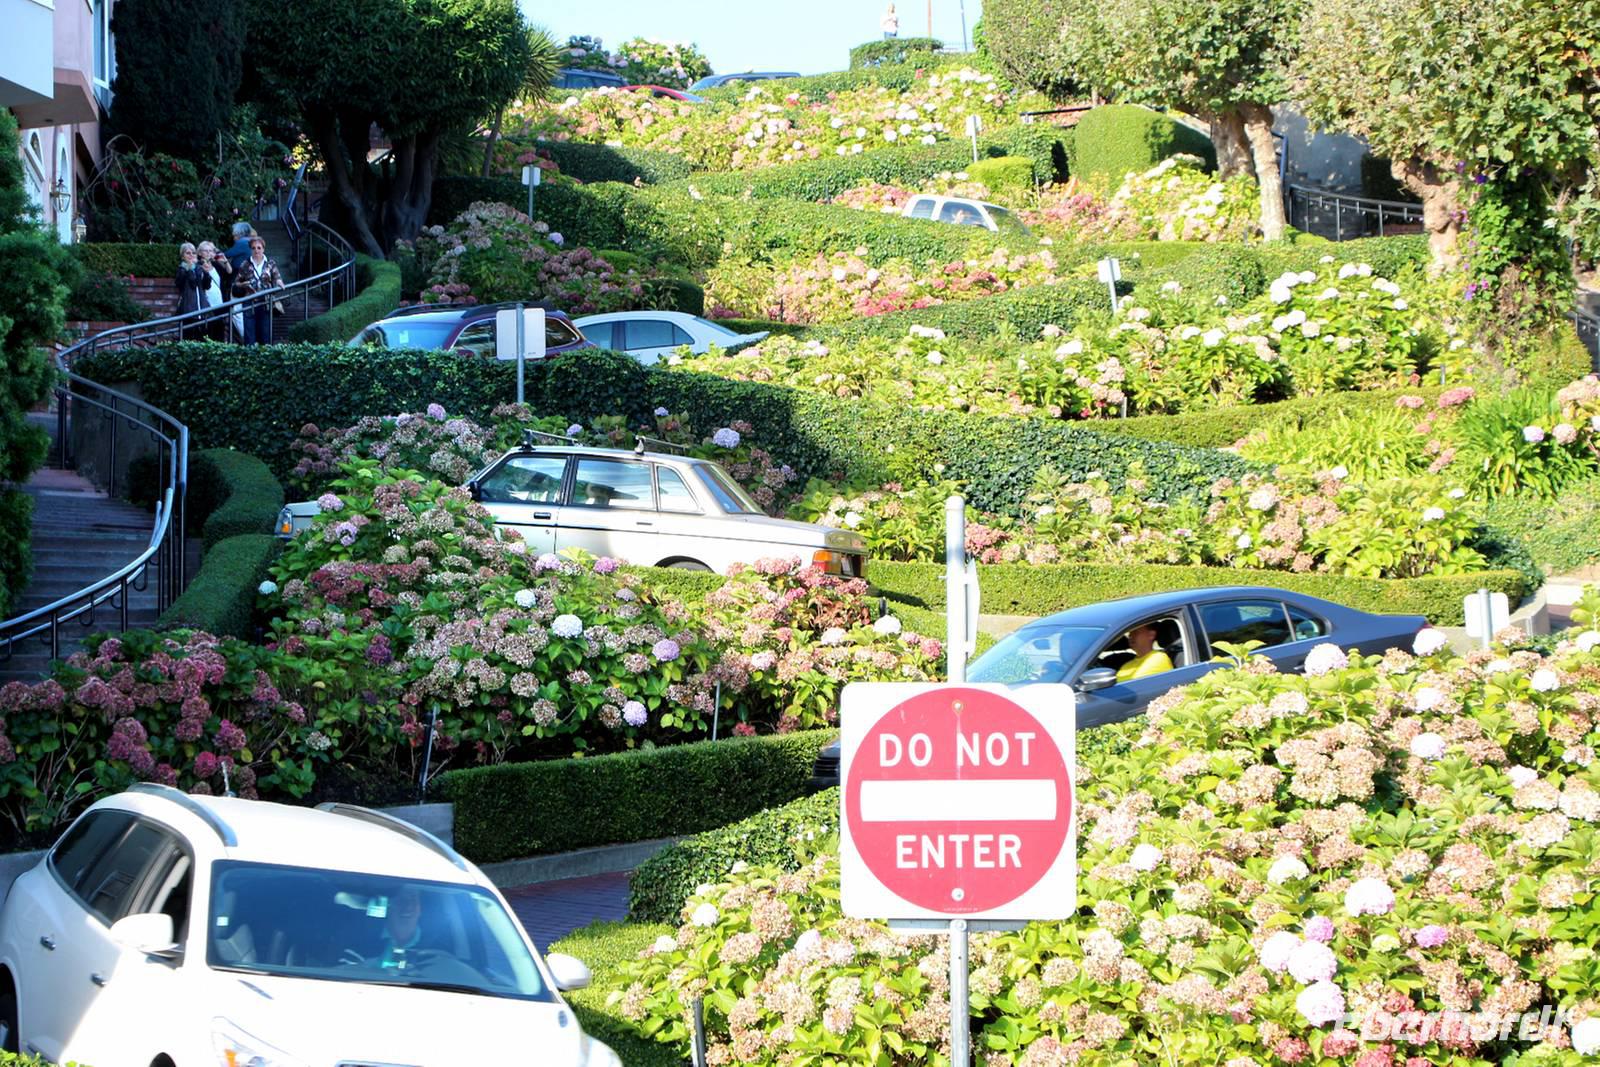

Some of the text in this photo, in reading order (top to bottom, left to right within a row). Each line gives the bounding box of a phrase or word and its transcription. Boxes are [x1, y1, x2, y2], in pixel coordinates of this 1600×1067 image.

[879, 732, 1036, 767] DO NOT
[896, 834, 1022, 869] ENTER
